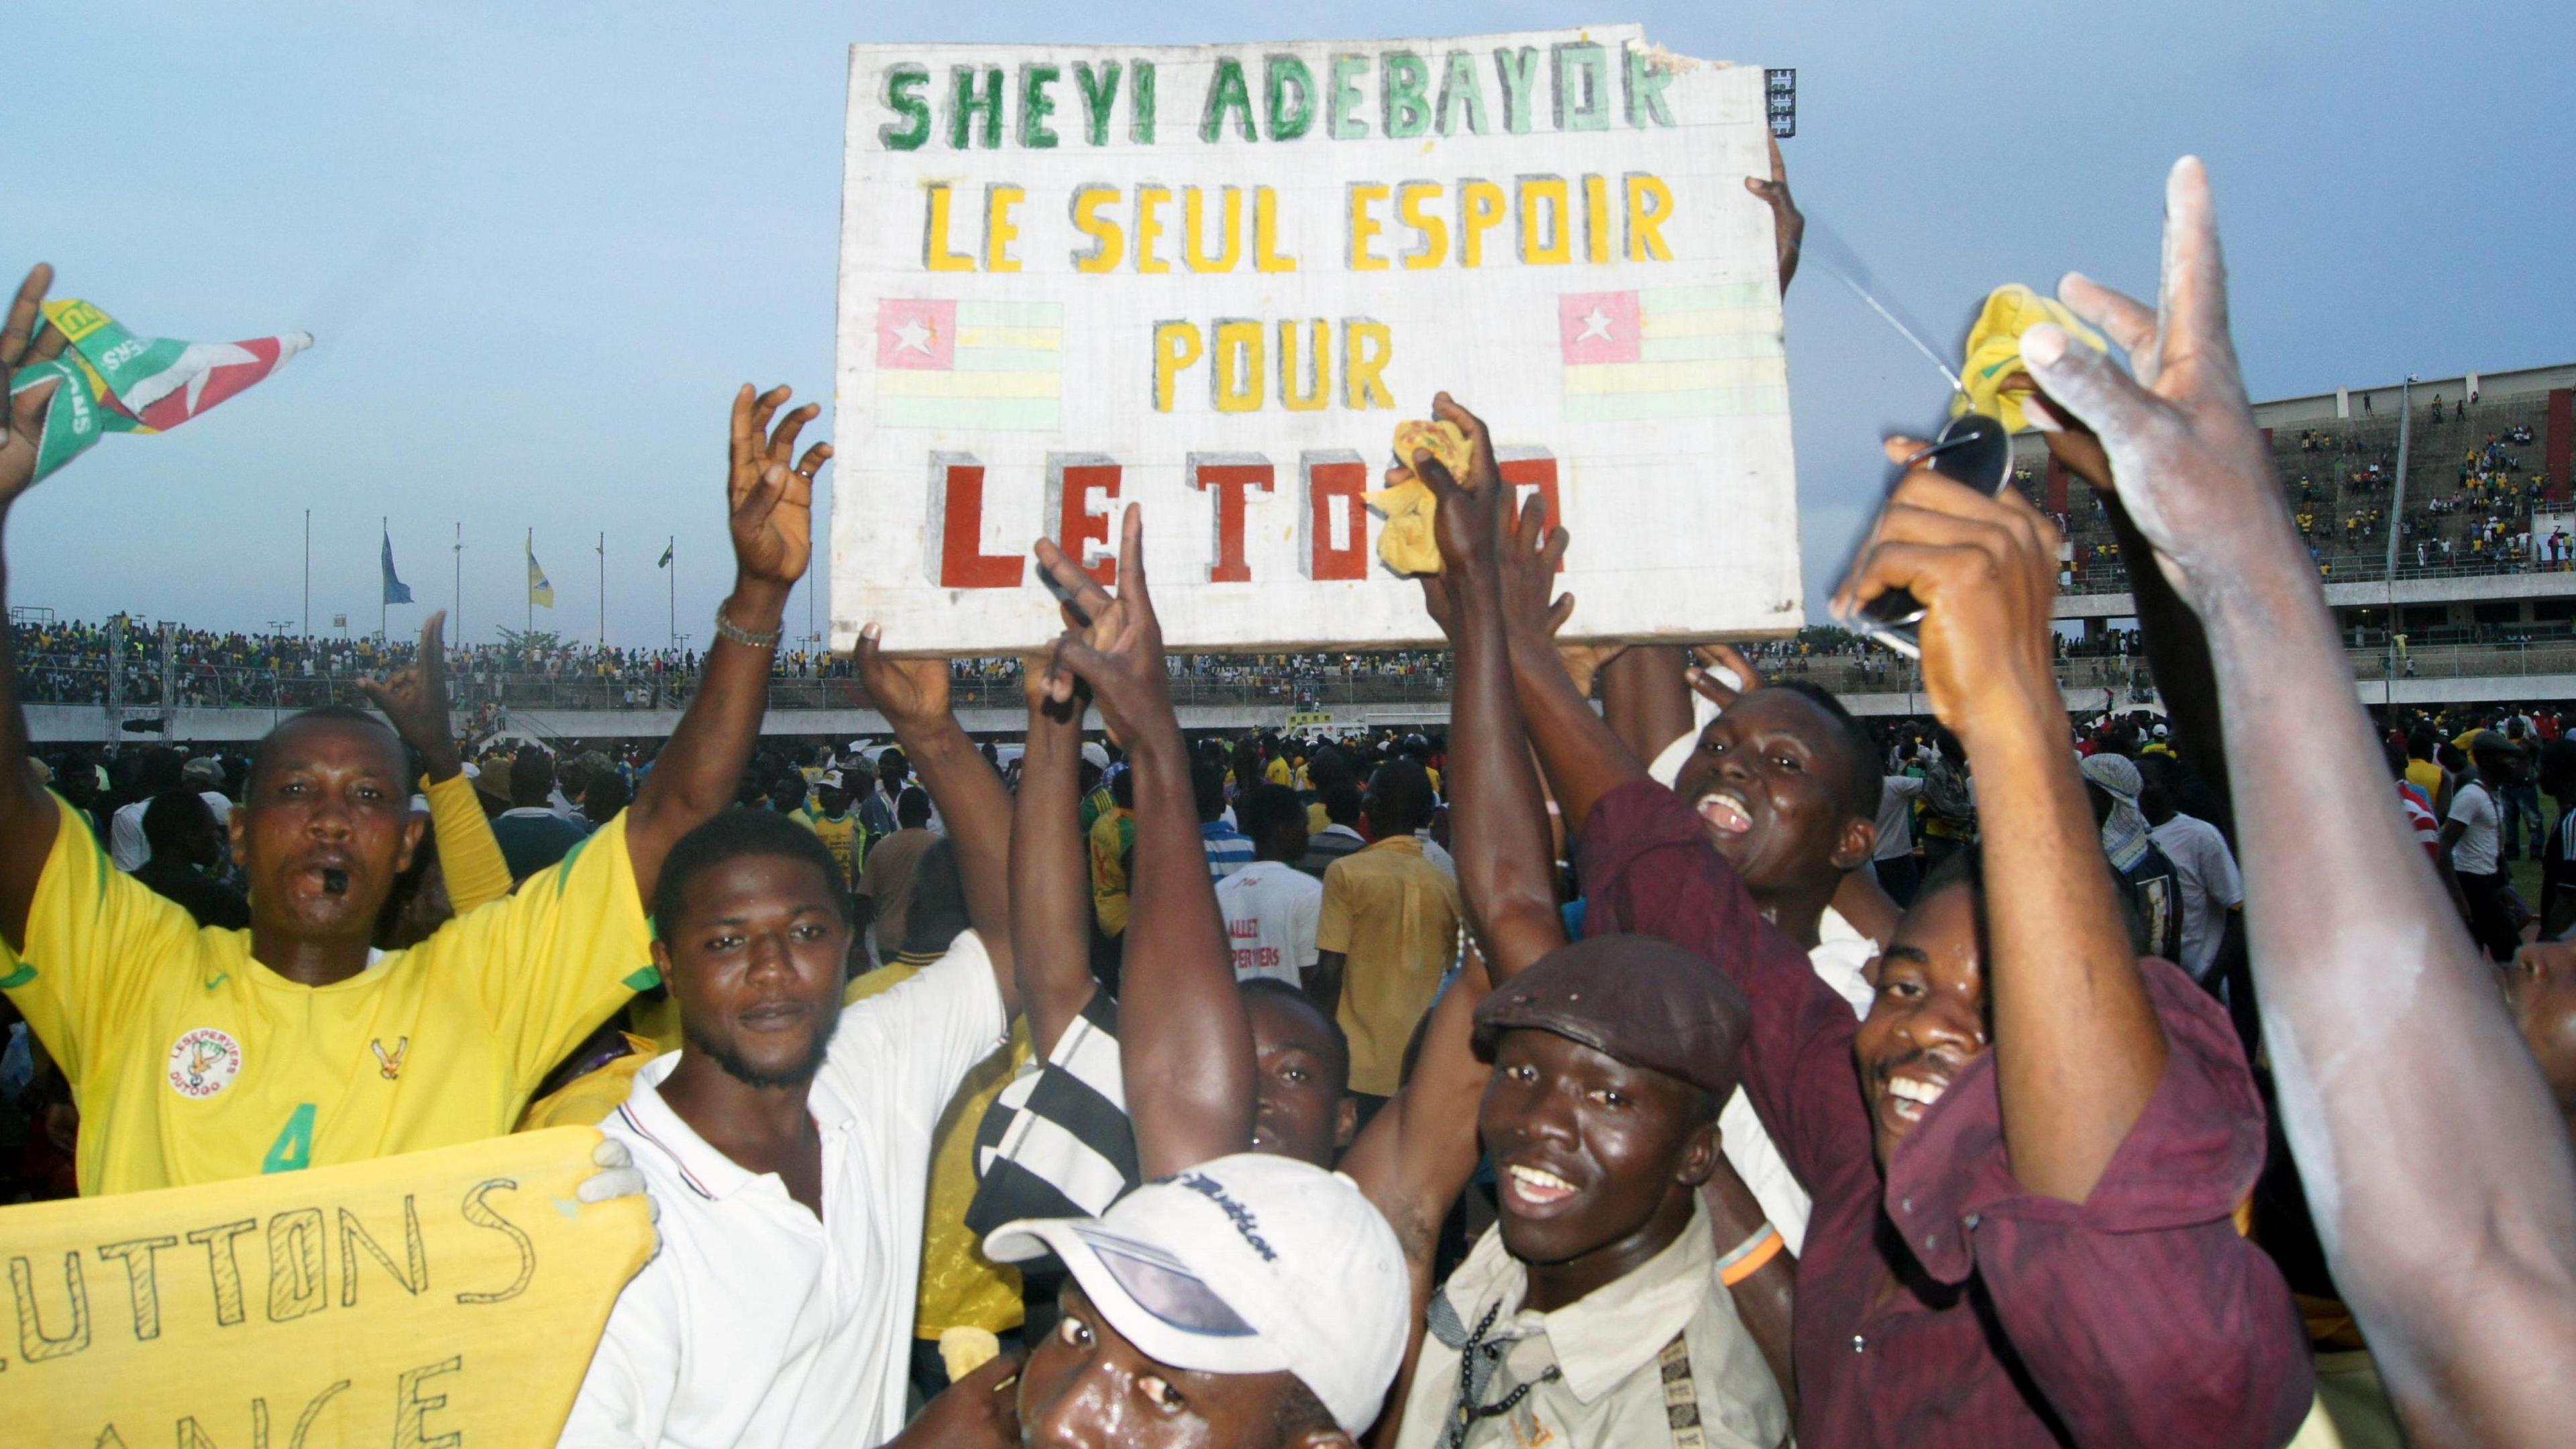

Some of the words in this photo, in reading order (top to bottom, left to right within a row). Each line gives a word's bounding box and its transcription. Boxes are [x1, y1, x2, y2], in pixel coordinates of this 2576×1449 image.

[877, 58, 1156, 150] SHEYI
[1199, 39, 1676, 143] ADEBAYOR
[922, 181, 1026, 273] LE
[1069, 182, 1296, 273] SEUL
[1345, 171, 1674, 271] ESPOIR
[1151, 317, 1395, 413] POUR
[1229, 919, 1258, 938] ALLEZ
[262, 1102, 317, 1174] 4
[0, 1179, 535, 1372] UTTONS
